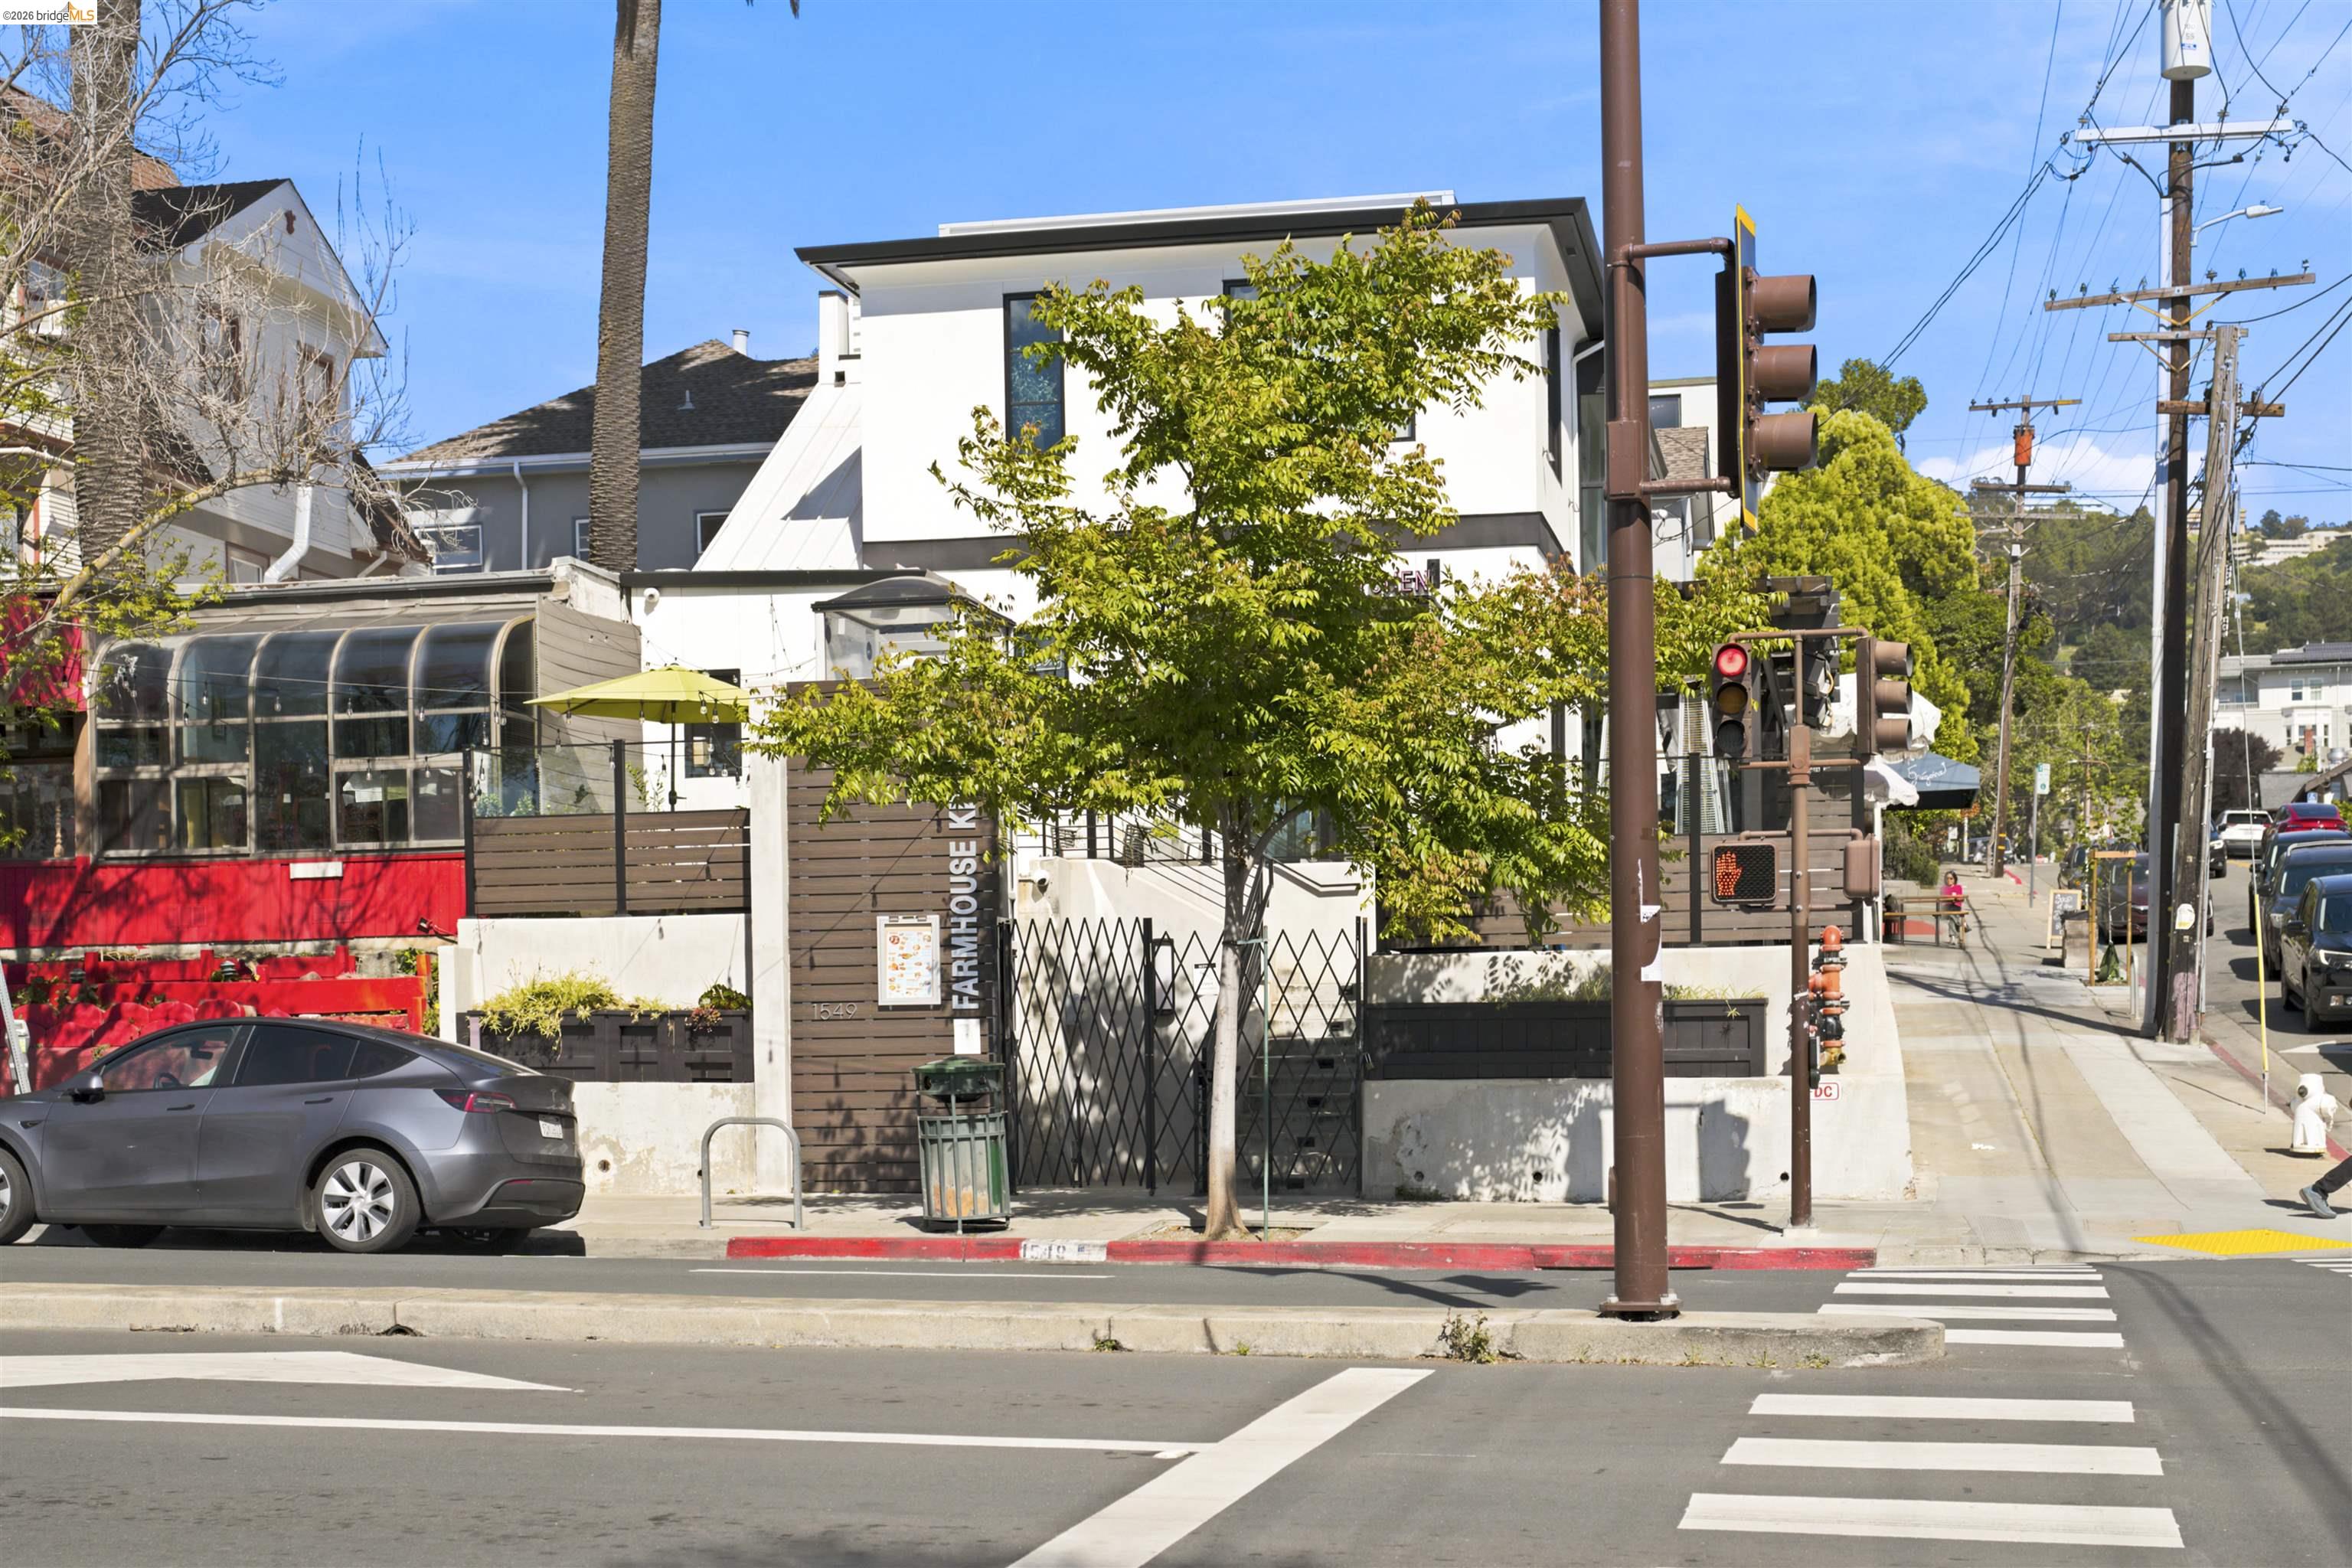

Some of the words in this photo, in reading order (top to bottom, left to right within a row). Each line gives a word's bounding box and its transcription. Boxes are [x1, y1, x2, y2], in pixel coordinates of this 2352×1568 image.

[949, 841, 979, 1010] FARMHOUSE
[812, 1003, 858, 1020] 1549
[1810, 1085, 1832, 1097] DC
